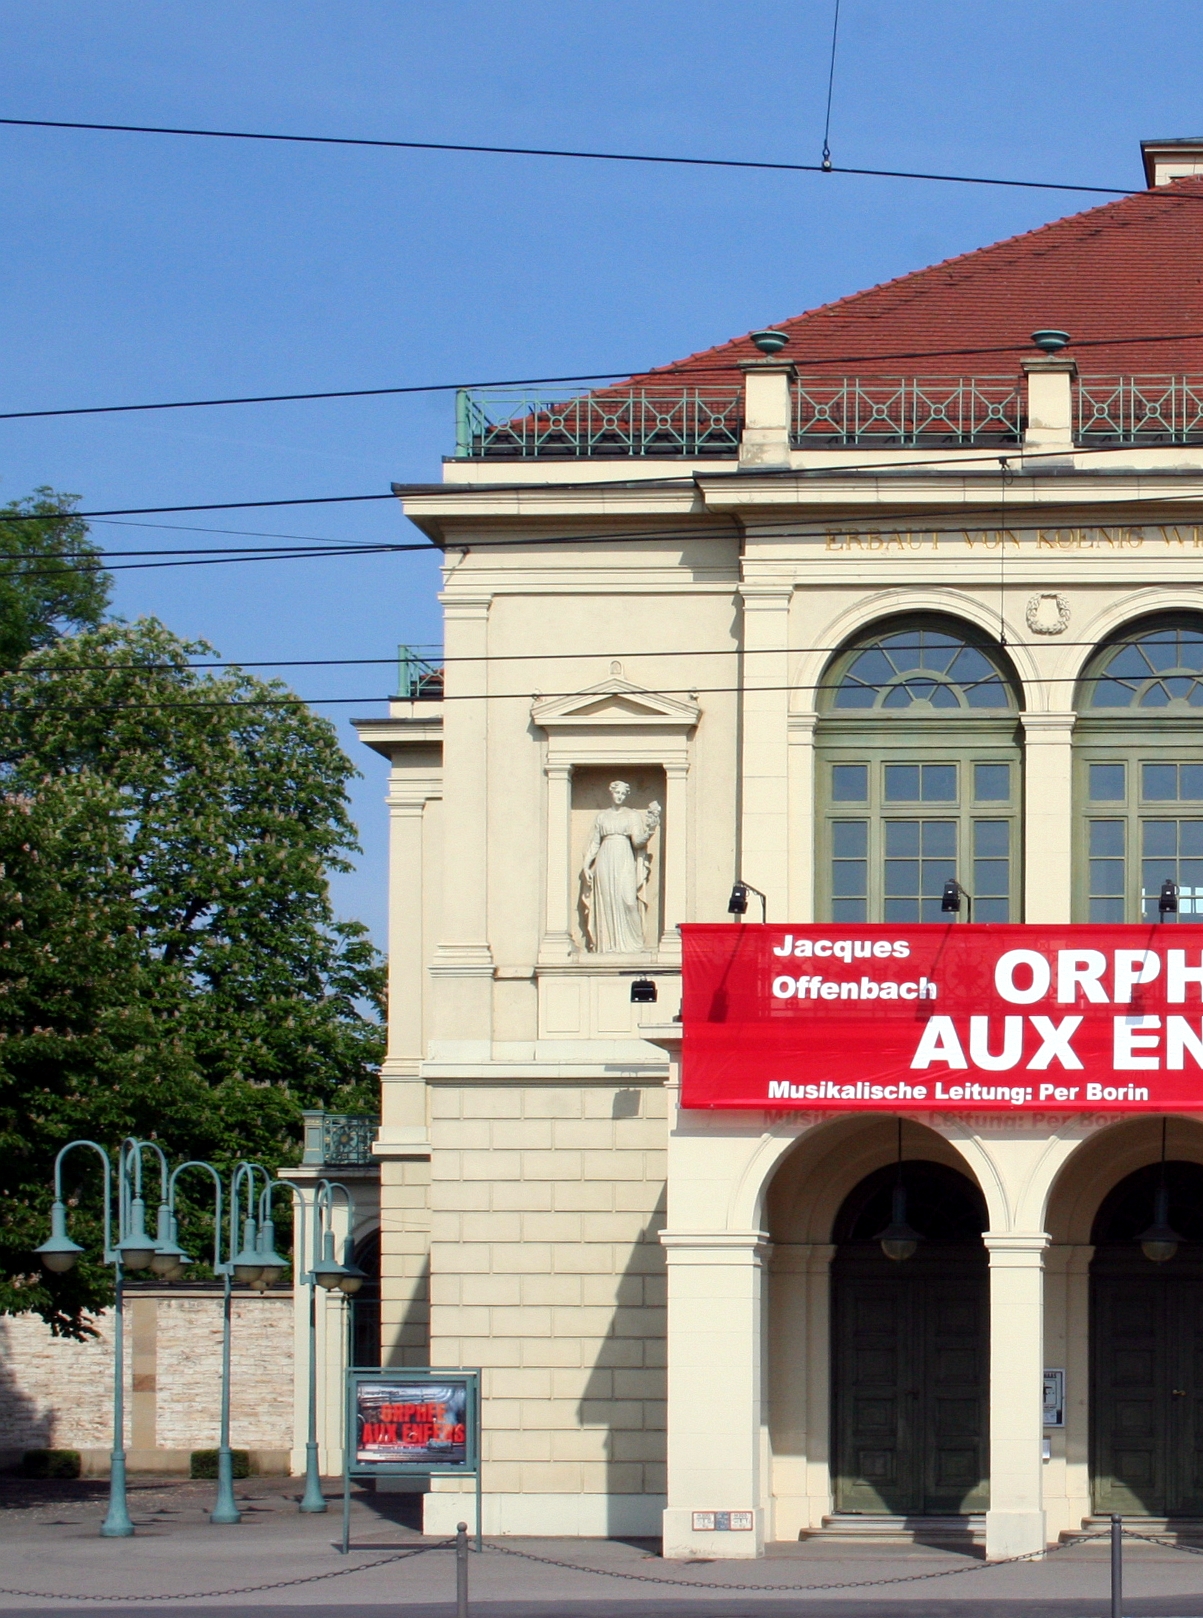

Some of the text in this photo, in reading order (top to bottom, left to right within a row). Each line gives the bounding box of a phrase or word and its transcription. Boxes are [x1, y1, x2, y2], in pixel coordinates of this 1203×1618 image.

[824, 527, 941, 551] ERBAUT
[959, 526, 1021, 550] VON
[1035, 526, 1145, 549] KOENIG
[772, 934, 911, 963] Jacques
[772, 975, 938, 1000] Offenbach
[909, 1015, 1086, 1072] AUX
[767, 1080, 1150, 1106] Musikalische Leitung: Per Borin
[362, 1423, 398, 1443] AUX
